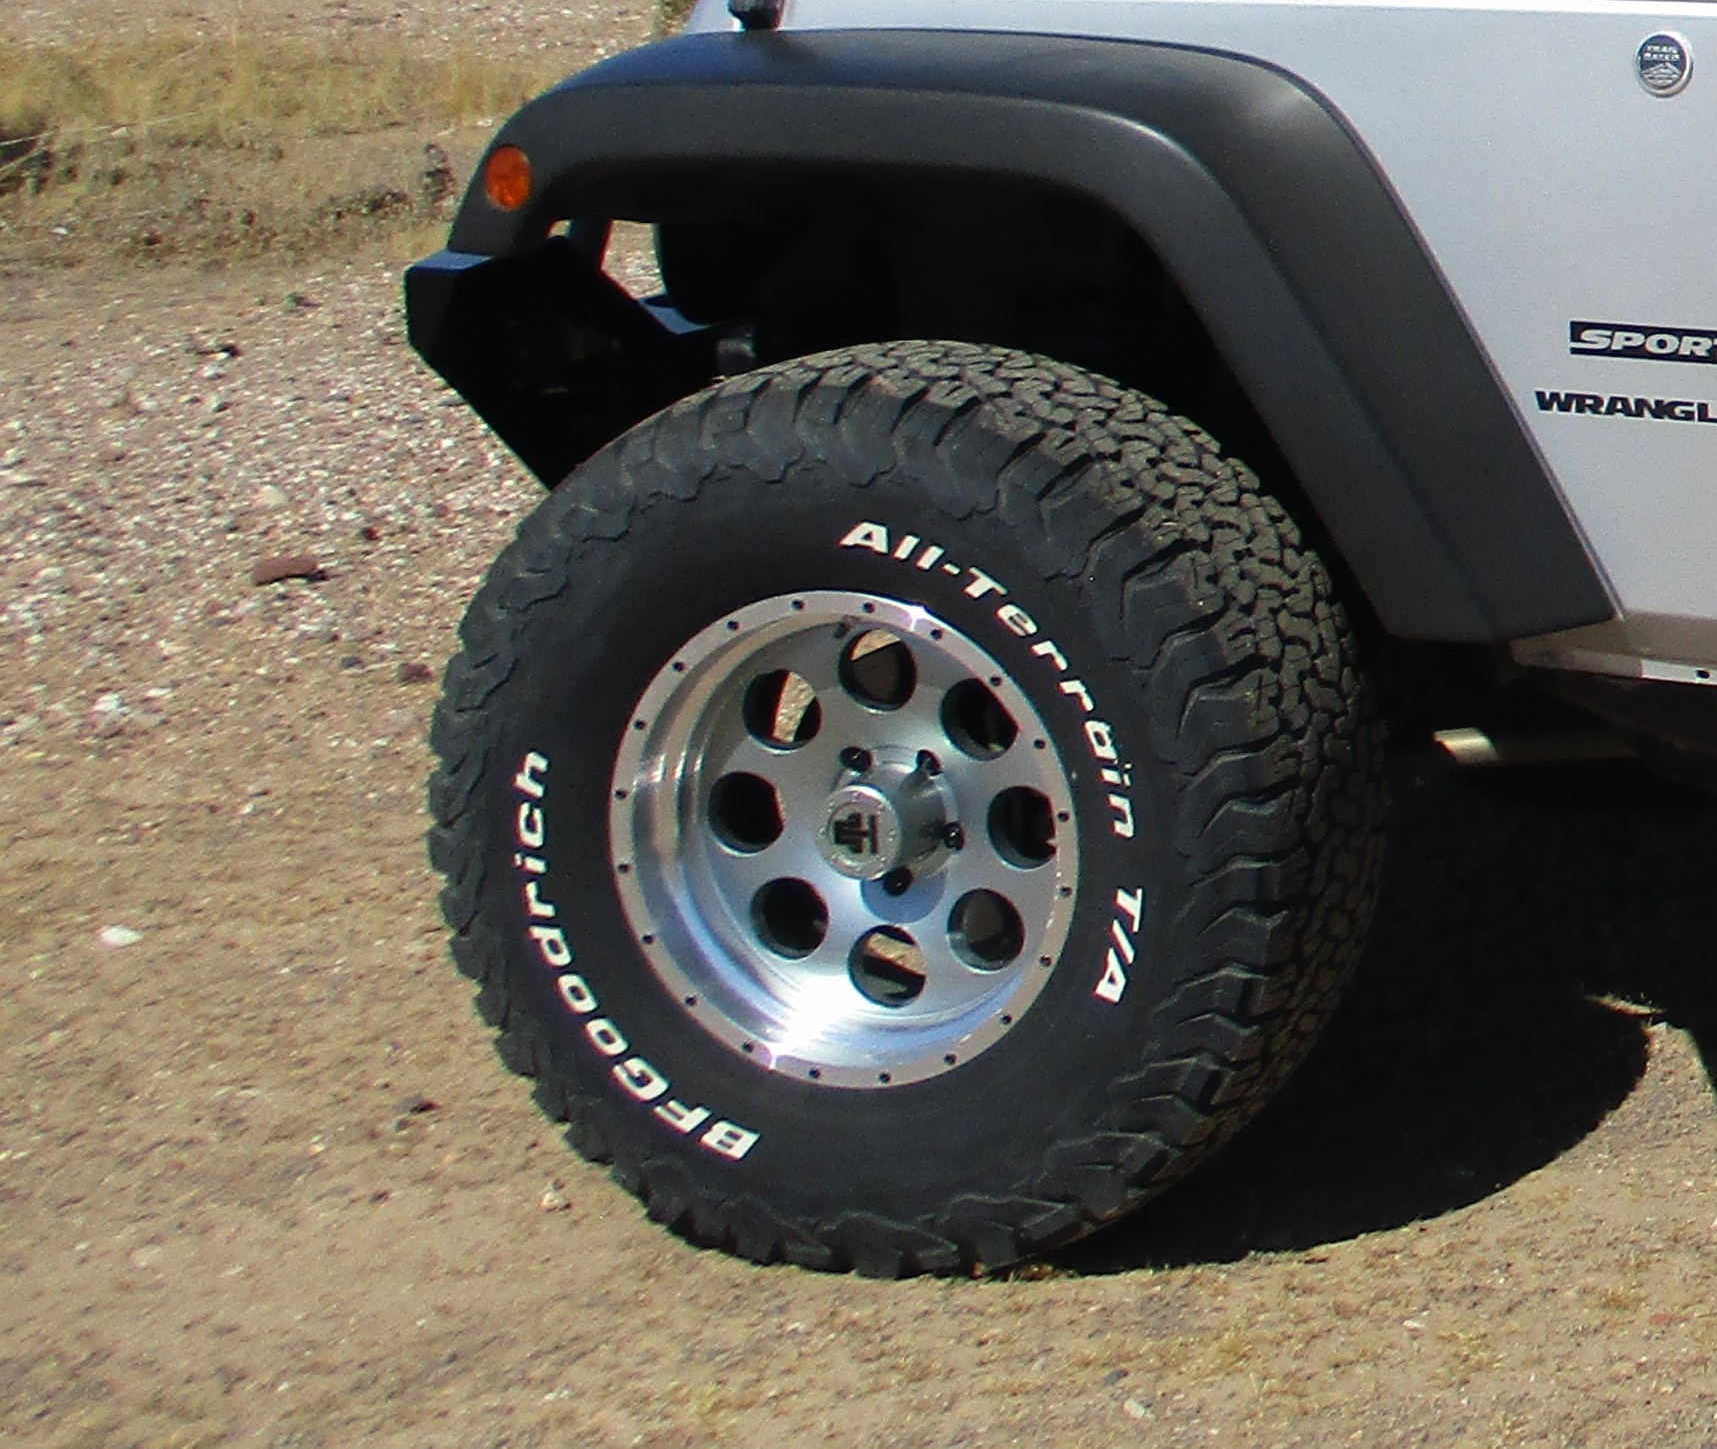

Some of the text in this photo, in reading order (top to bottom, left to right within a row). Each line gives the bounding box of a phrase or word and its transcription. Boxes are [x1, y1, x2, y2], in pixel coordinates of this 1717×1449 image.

[513, 750, 761, 1161] BFGoodrich
[839, 520, 1145, 1004] All-Terrain T/A
